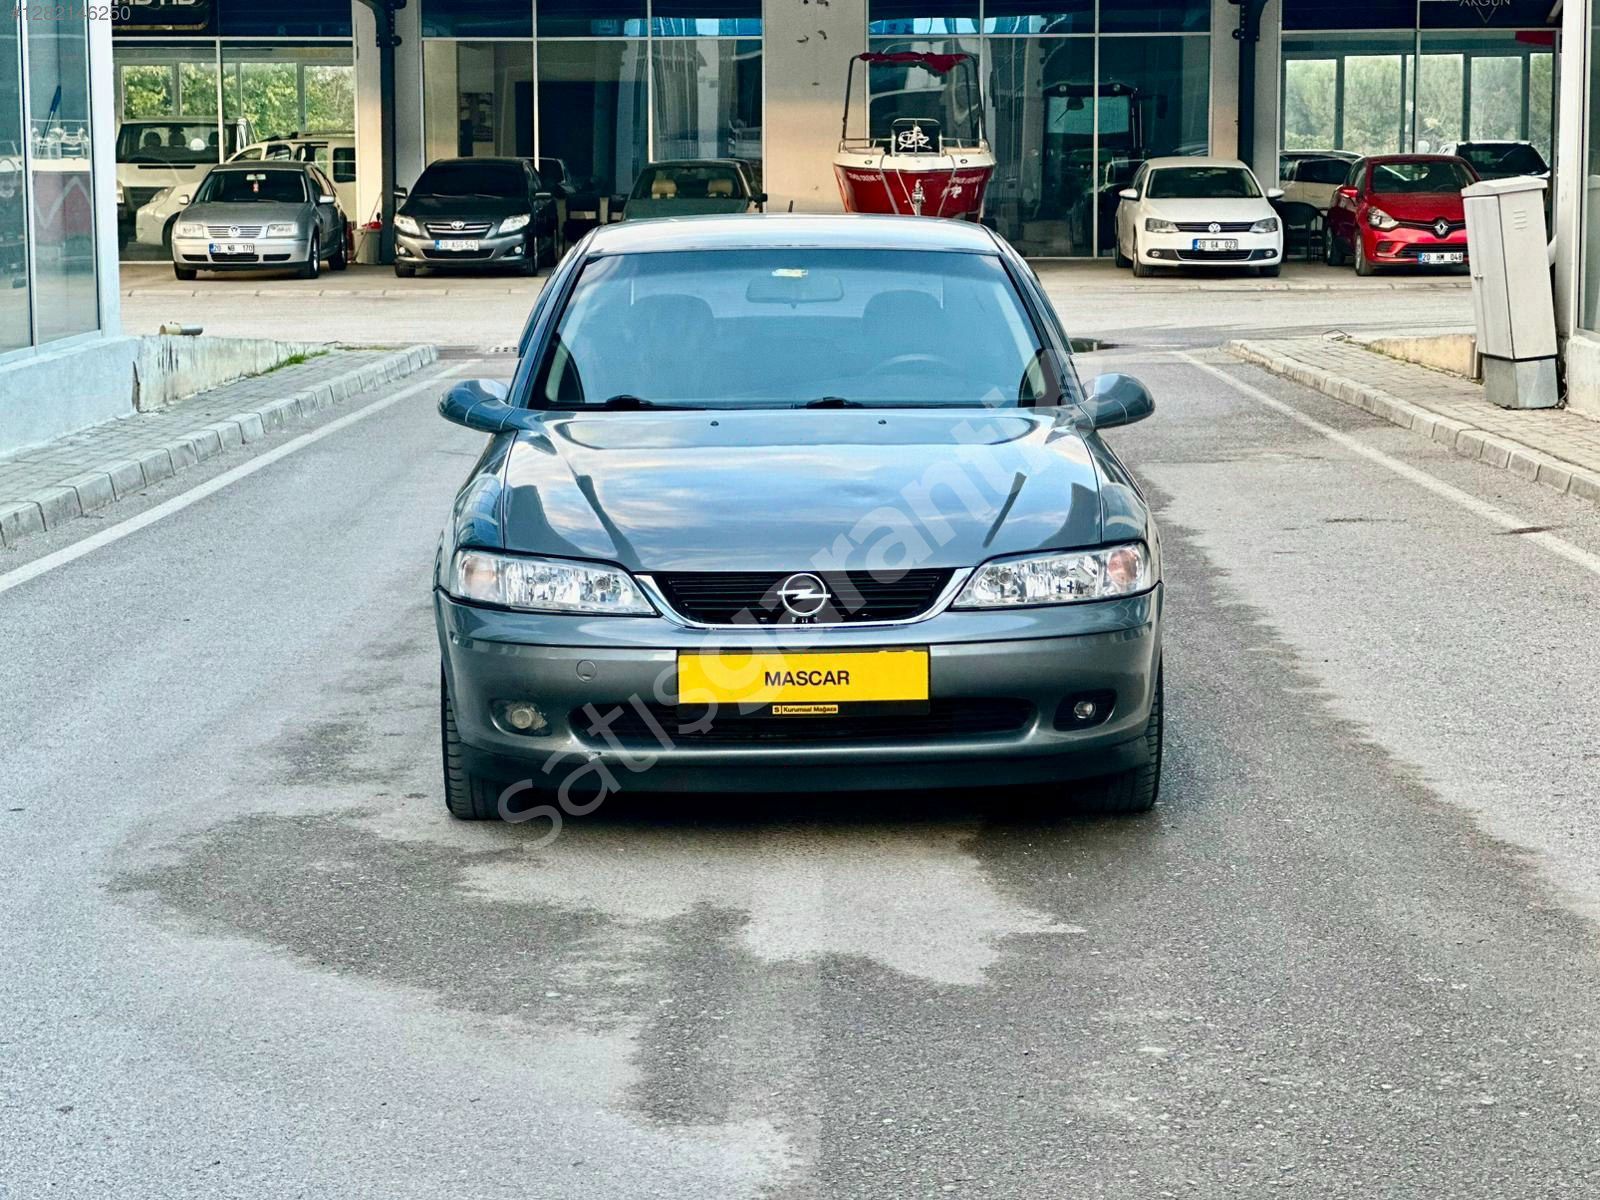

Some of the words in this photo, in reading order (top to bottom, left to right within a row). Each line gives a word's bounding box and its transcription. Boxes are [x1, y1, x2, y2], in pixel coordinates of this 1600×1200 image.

[243, 244, 253, 252] 170
[1198, 240, 1206, 248] 20
[1224, 240, 1237, 249] 023
[1422, 253, 1431, 261] 20
[764, 670, 850, 687] MASCAR
